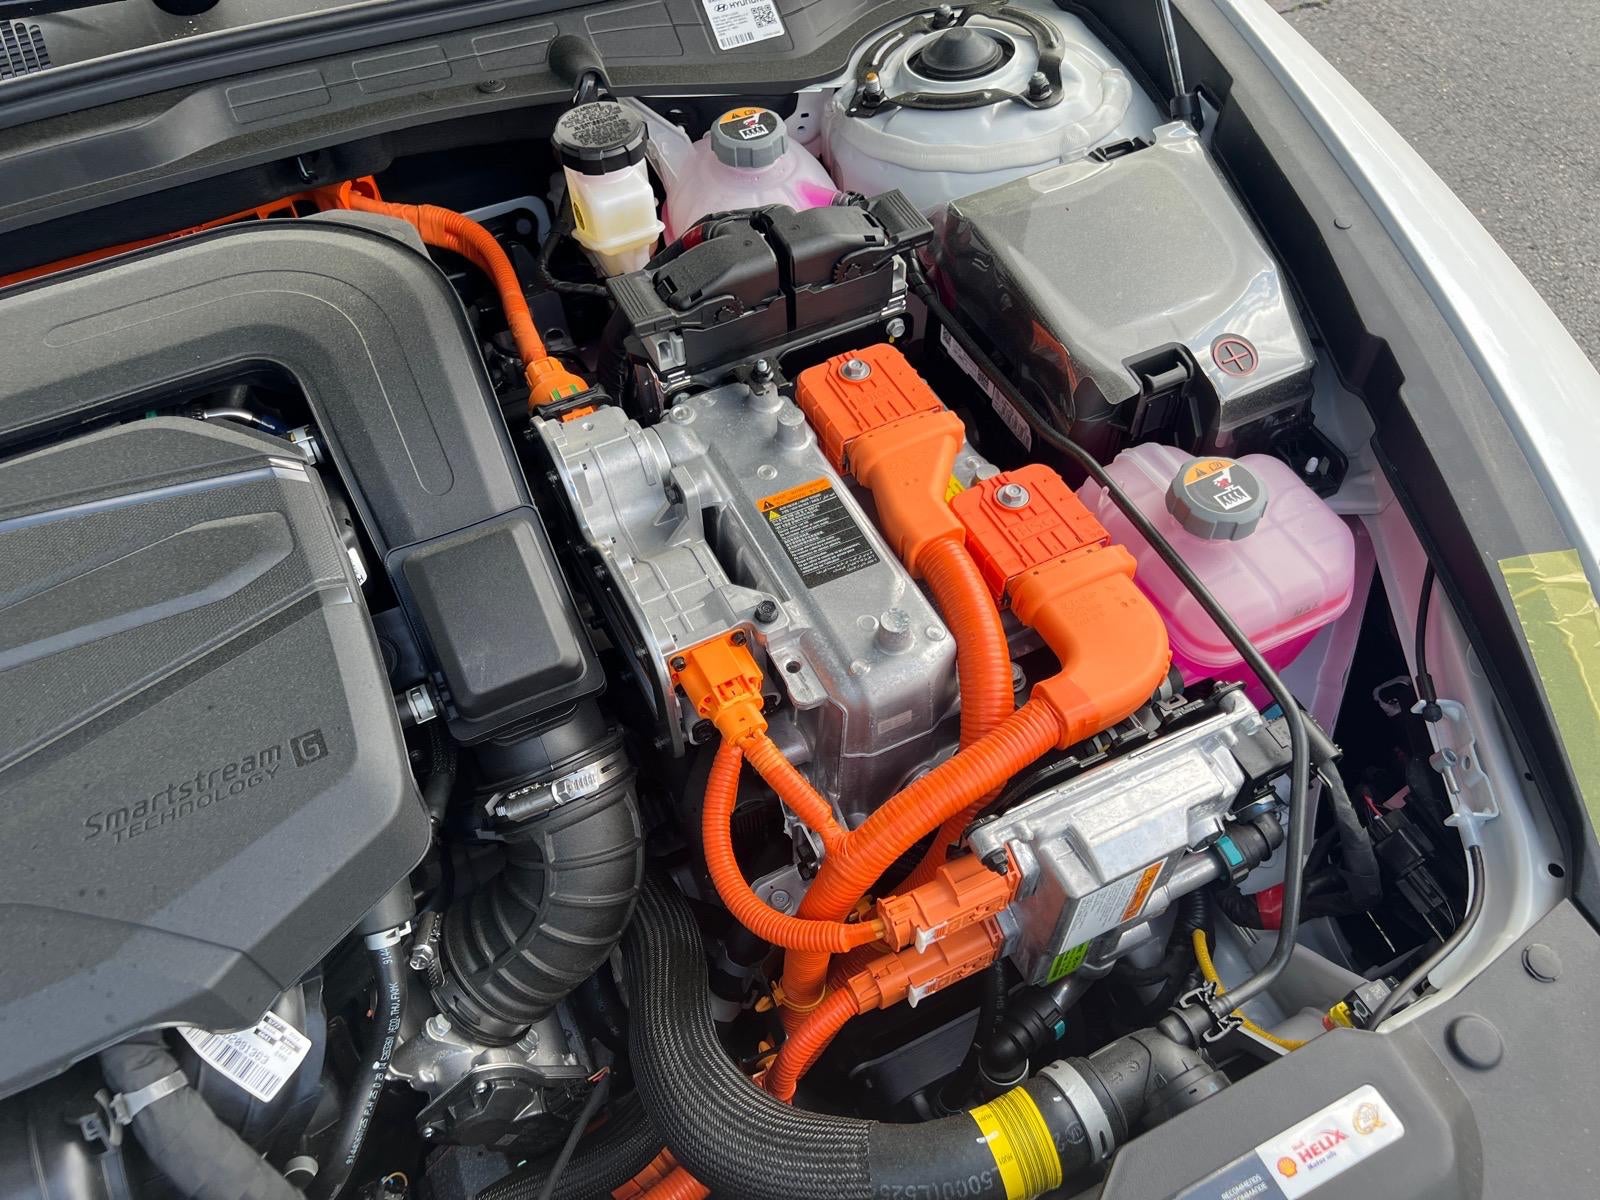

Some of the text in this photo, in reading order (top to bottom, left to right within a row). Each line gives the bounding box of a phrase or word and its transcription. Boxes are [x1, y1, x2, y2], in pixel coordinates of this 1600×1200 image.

[83, 743, 281, 841] Smartstream
[112, 763, 281, 844] TECHNOLOGY
[1298, 1130, 1348, 1163] HELIX
